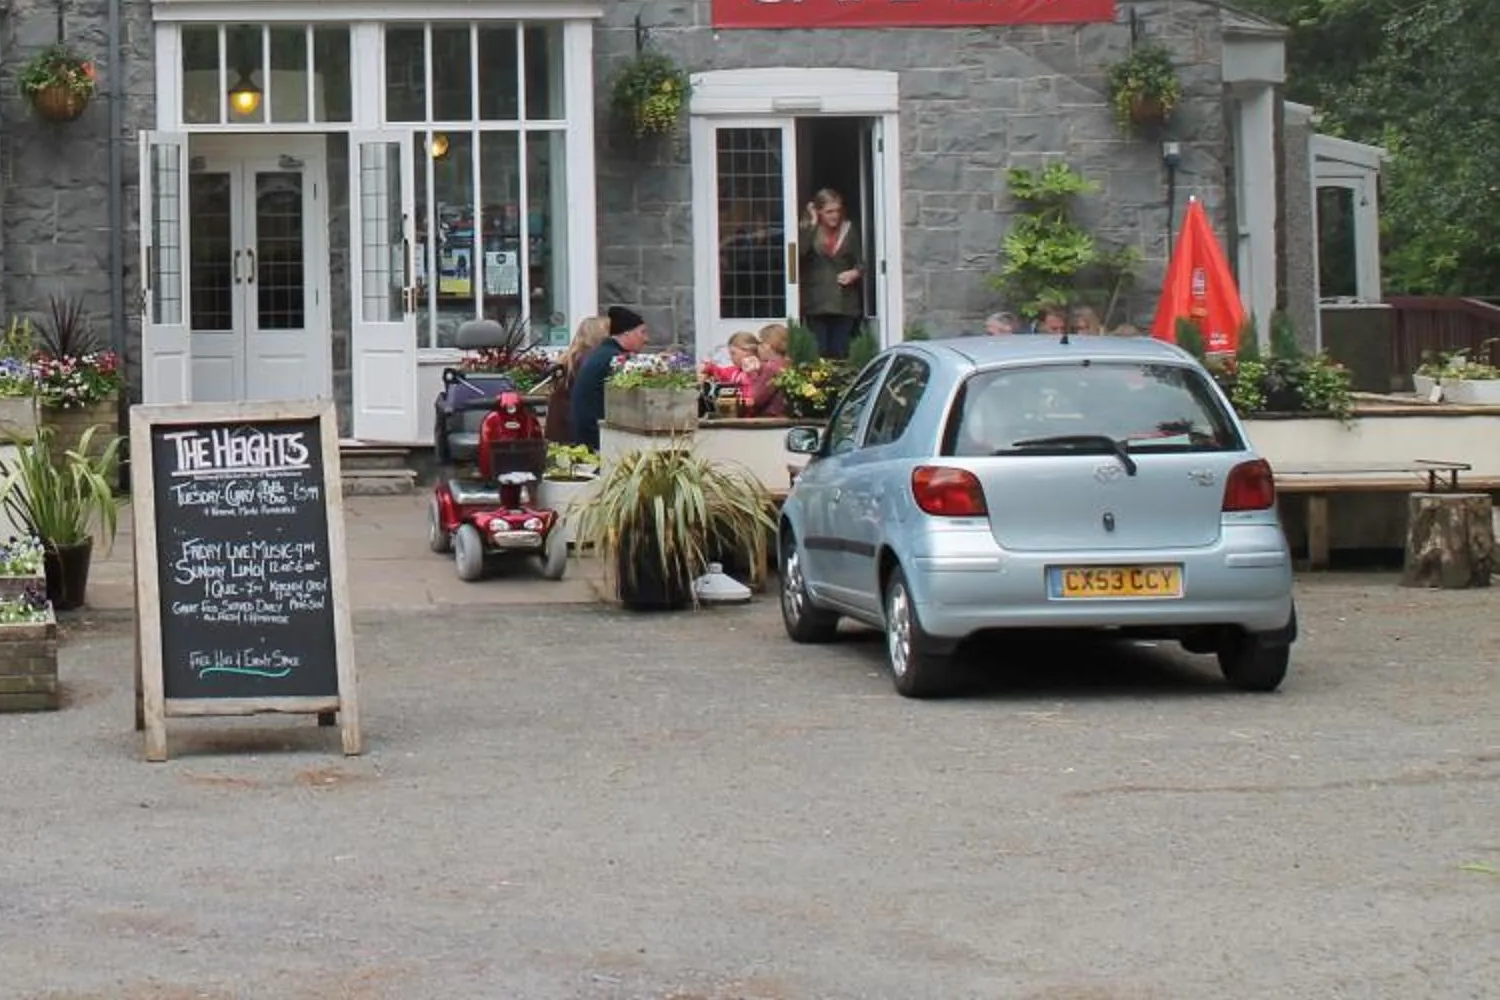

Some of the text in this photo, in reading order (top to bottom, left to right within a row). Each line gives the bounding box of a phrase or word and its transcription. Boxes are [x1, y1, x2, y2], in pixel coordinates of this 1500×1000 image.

[164, 428, 309, 471] THE HEIGHTS
[181, 538, 222, 561] FRIDAY
[226, 541, 252, 559] LIVE
[174, 559, 226, 584] SUNDAY
[231, 558, 266, 581] LUNCH
[1065, 568, 1174, 592] CX53 CCY
